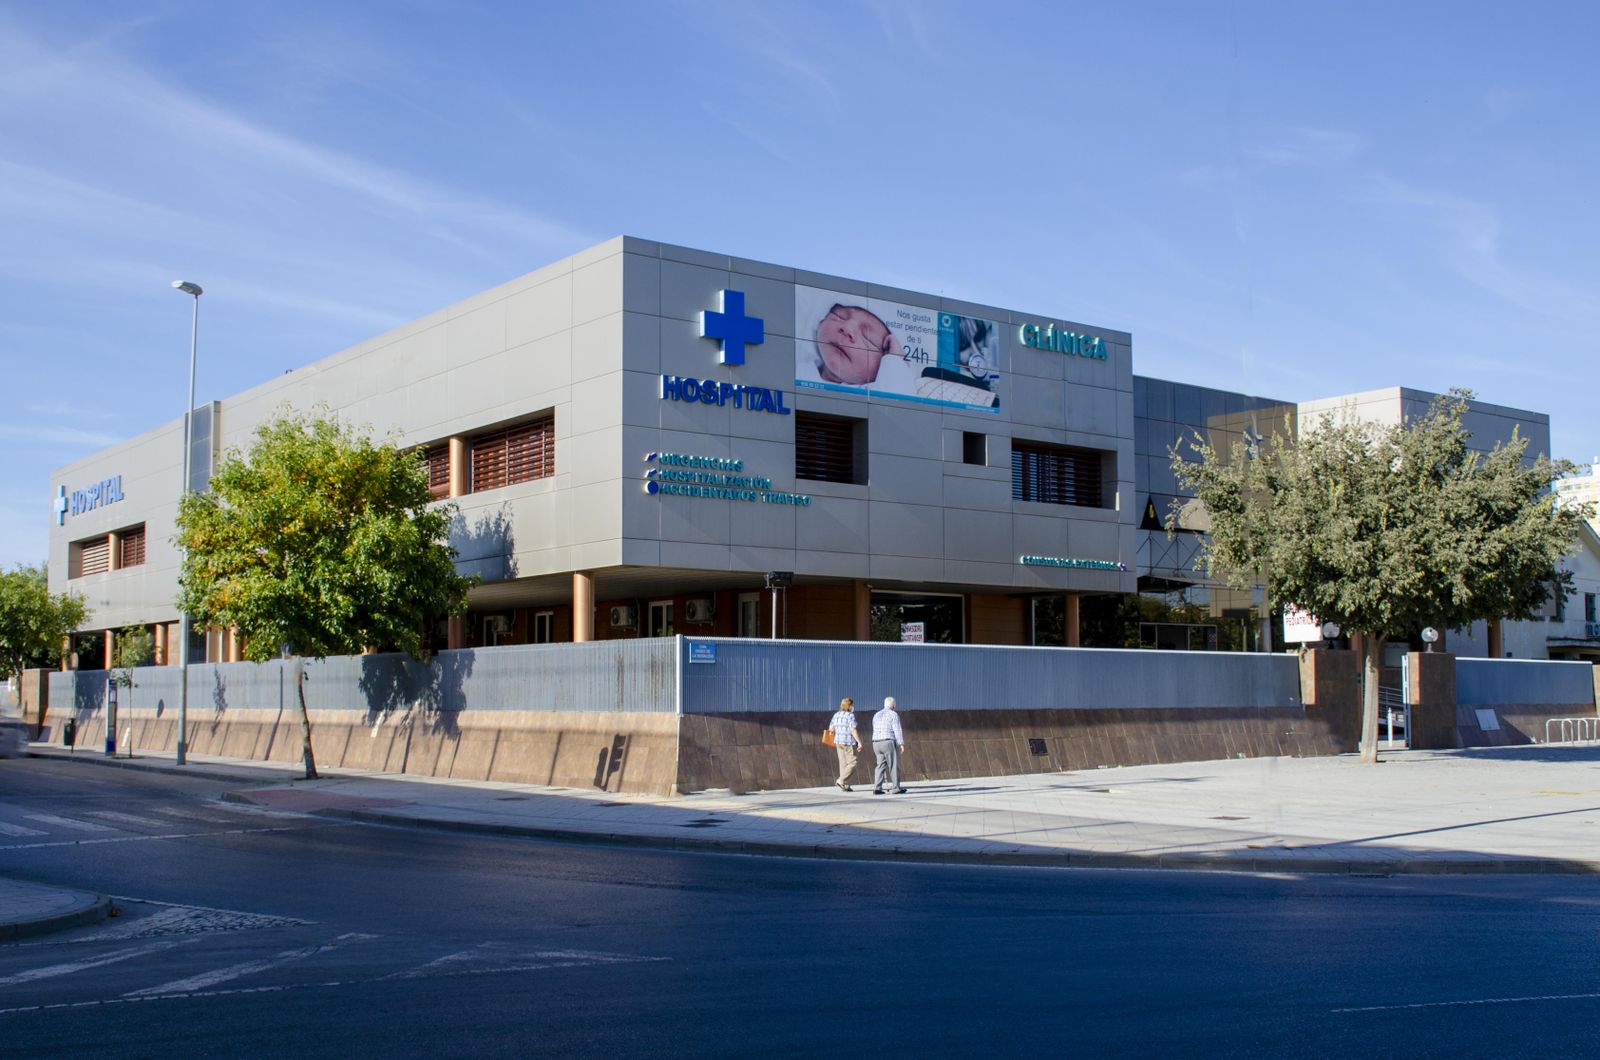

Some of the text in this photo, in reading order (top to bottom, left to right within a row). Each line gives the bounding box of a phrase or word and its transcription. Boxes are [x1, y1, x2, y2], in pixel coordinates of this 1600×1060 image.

[896, 309, 931, 323] Nos gusta
[886, 319, 903, 329] estar
[904, 323, 941, 336] pendiente
[907, 334, 916, 343] de
[1019, 322, 1107, 361] CLÍNICA
[902, 345, 929, 364] 24h
[660, 374, 791, 415] HOSPITAL
[660, 452, 744, 472] URGENCIAS
[659, 469, 772, 489] HOSPITALIZACIÓN
[72, 475, 125, 517] HOSPITAL
[660, 483, 756, 502] ACCIDENTADOS
